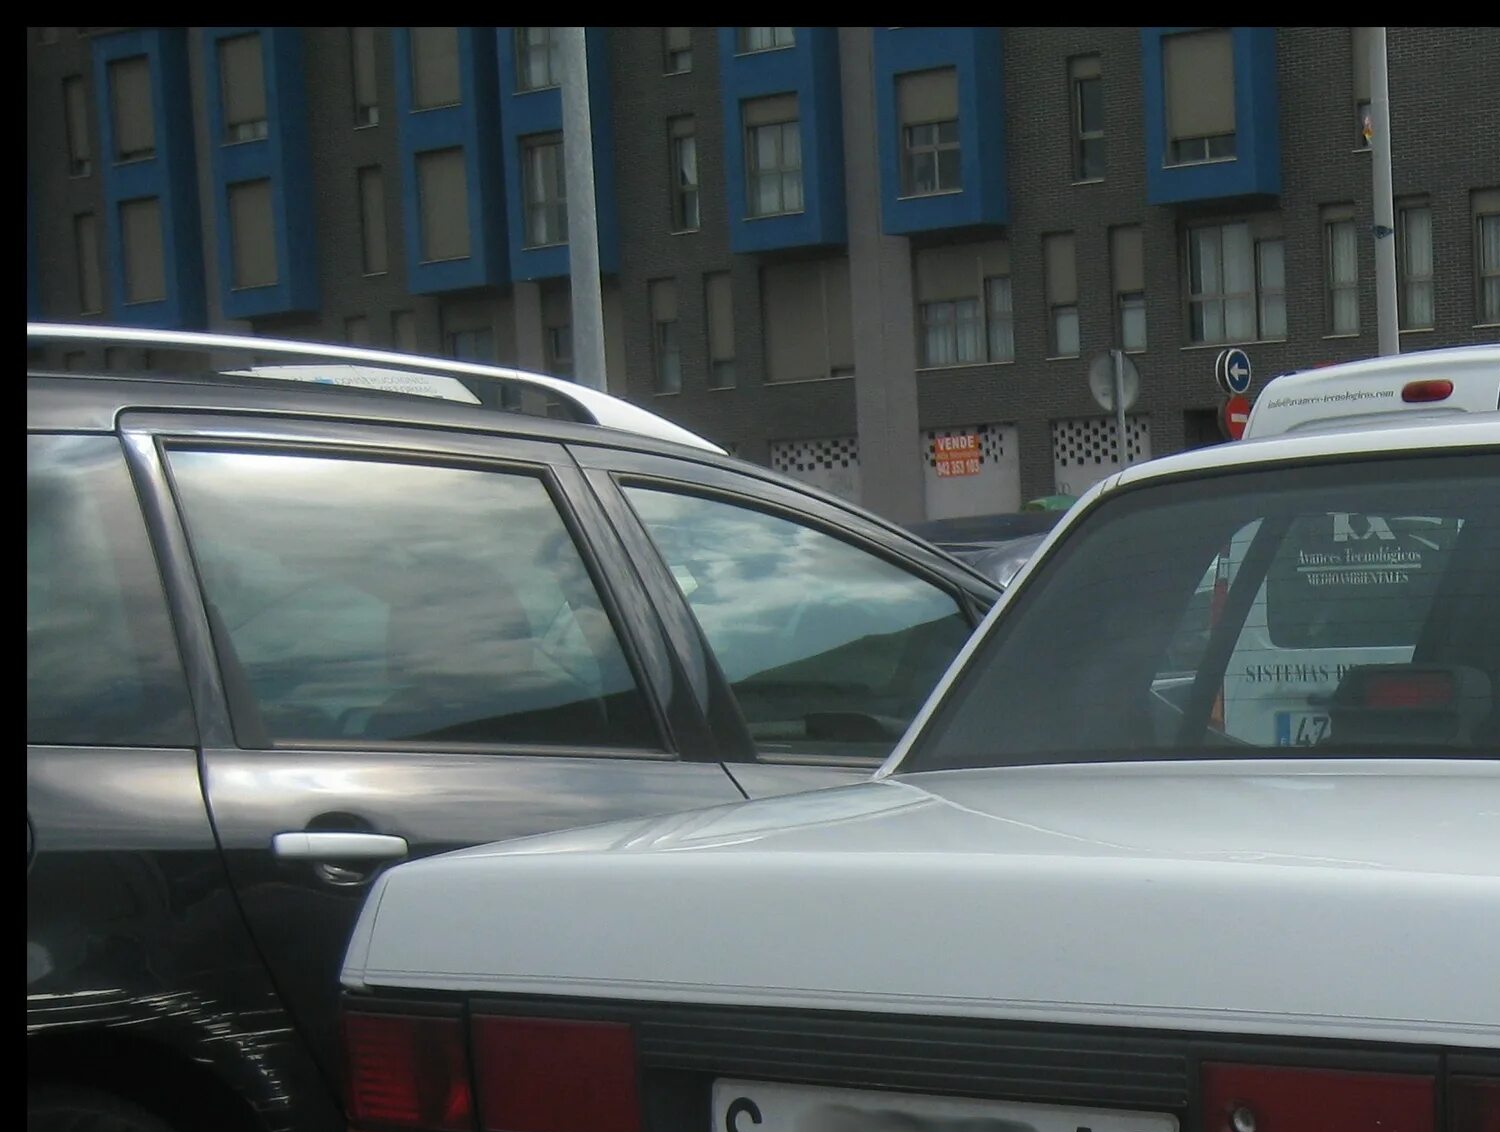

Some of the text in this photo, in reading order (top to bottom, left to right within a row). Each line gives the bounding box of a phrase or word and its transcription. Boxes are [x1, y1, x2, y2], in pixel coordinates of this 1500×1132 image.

[937, 435, 975, 451] VENDE
[1298, 550, 1341, 565] Avances
[1246, 663, 1330, 683] SISTEMAS
[1295, 716, 1331, 746] 47
